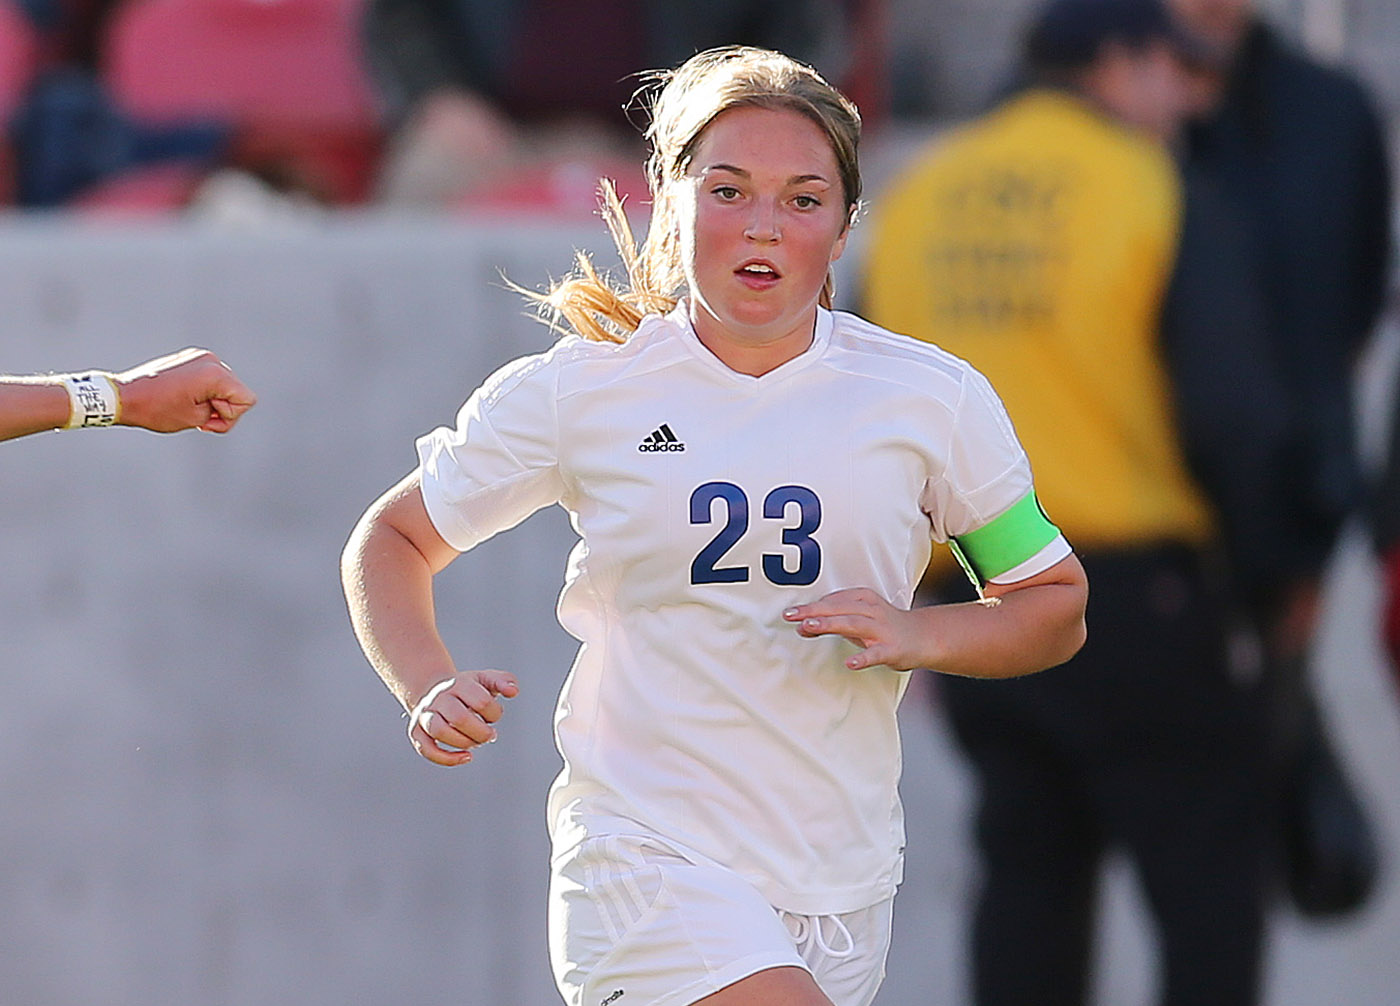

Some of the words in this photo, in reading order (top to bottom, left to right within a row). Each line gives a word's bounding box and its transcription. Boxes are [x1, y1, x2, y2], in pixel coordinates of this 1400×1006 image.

[76, 392, 101, 403] THE
[638, 441, 686, 453] adidas
[688, 480, 823, 586] 23
